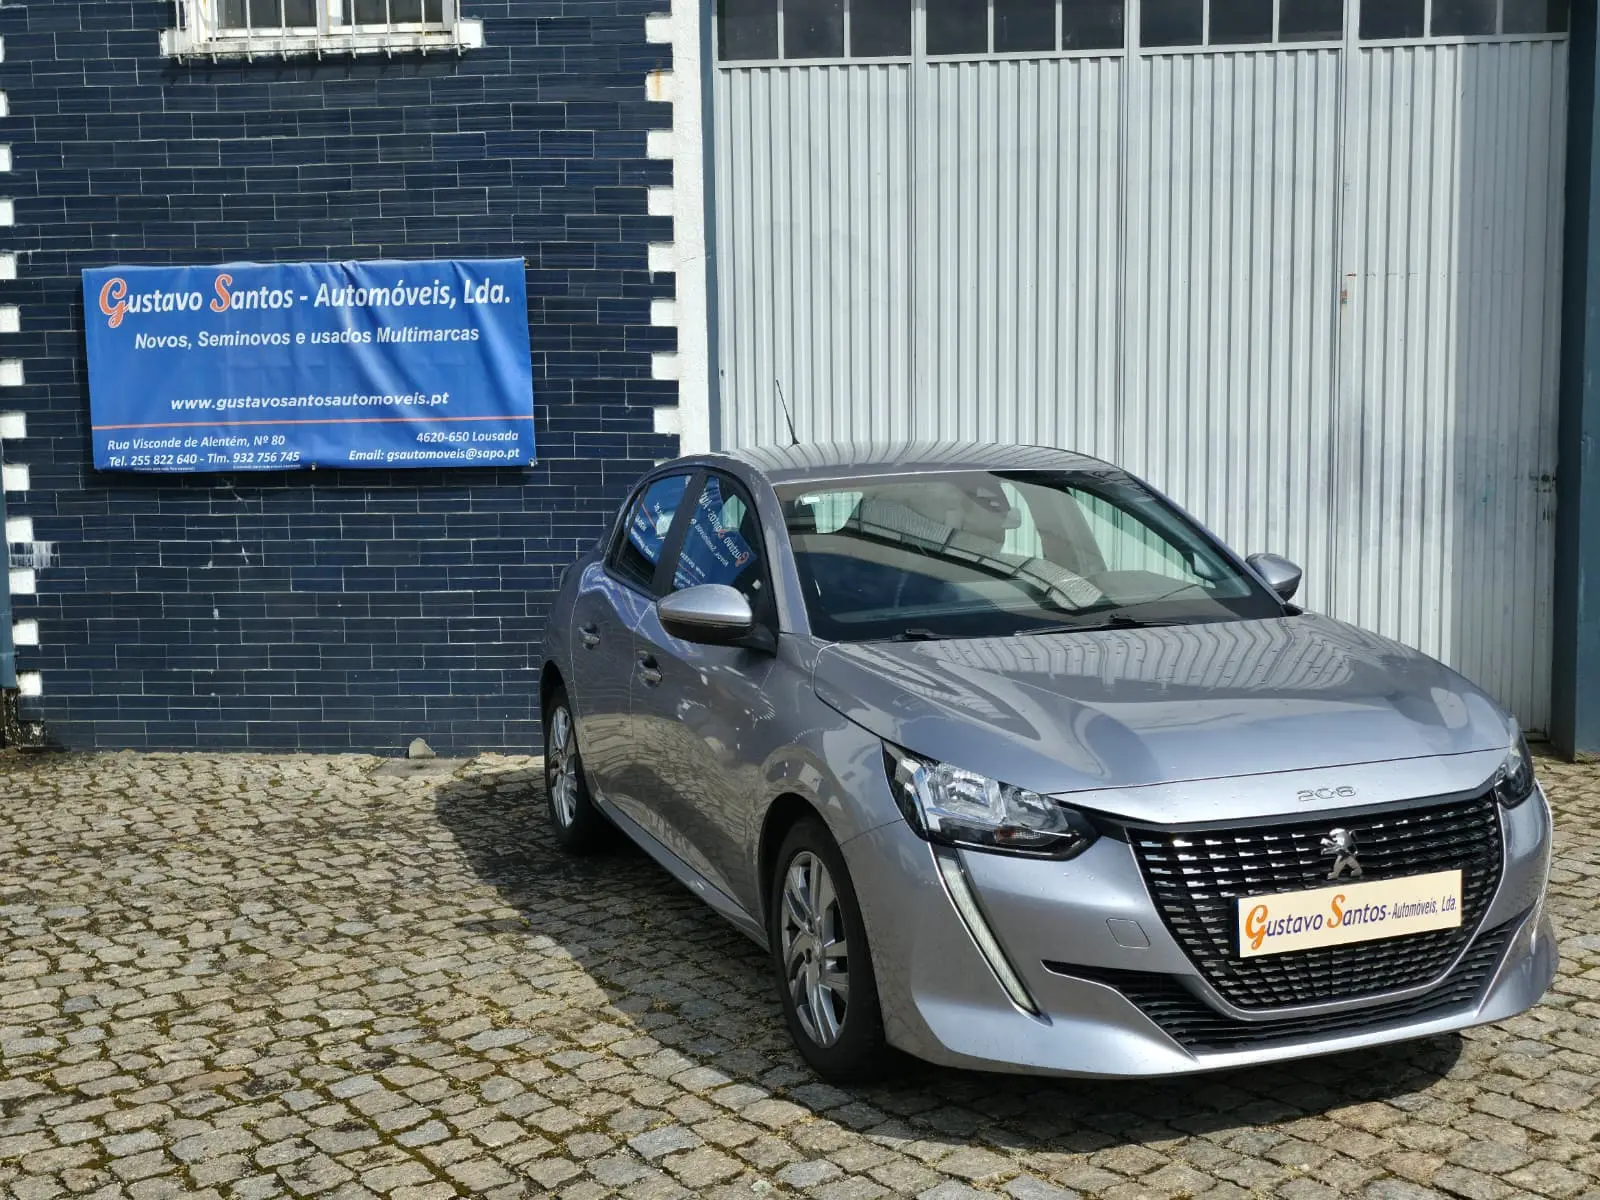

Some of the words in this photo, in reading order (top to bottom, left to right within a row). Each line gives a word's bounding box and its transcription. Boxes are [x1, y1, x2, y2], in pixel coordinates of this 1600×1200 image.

[99, 277, 203, 328] Gustavo
[210, 274, 294, 312] Santos
[314, 279, 457, 309] Automóveis,
[463, 278, 511, 304] Lda.
[135, 333, 192, 350] Novos,
[198, 330, 291, 347] Seminovos
[295, 332, 306, 345] e
[311, 328, 372, 344] usados
[377, 326, 480, 343] Multimarcas
[170, 391, 450, 411] www.gustavosantosautomoveis.pt
[107, 439, 130, 451] Rua
[133, 437, 182, 449] Visconde
[184, 436, 198, 448] de
[200, 435, 250, 448] Alentém,
[271, 435, 286, 446] 80
[416, 431, 469, 443] 4620-650
[472, 430, 519, 442] Lousada
[109, 456, 127, 468] Tel.
[131, 455, 151, 466] 255
[153, 454, 173, 465] 822
[176, 454, 198, 465] 640
[233, 452, 254, 463] 932
[256, 452, 278, 463] 756
[279, 451, 300, 463] 745
[349, 449, 384, 461] Email:
[386, 448, 520, 462] gsautomoveis@sapo.pt
[1297, 786, 1356, 801] 208
[1245, 905, 1323, 950] Gustavo
[1326, 894, 1387, 928] Santos
